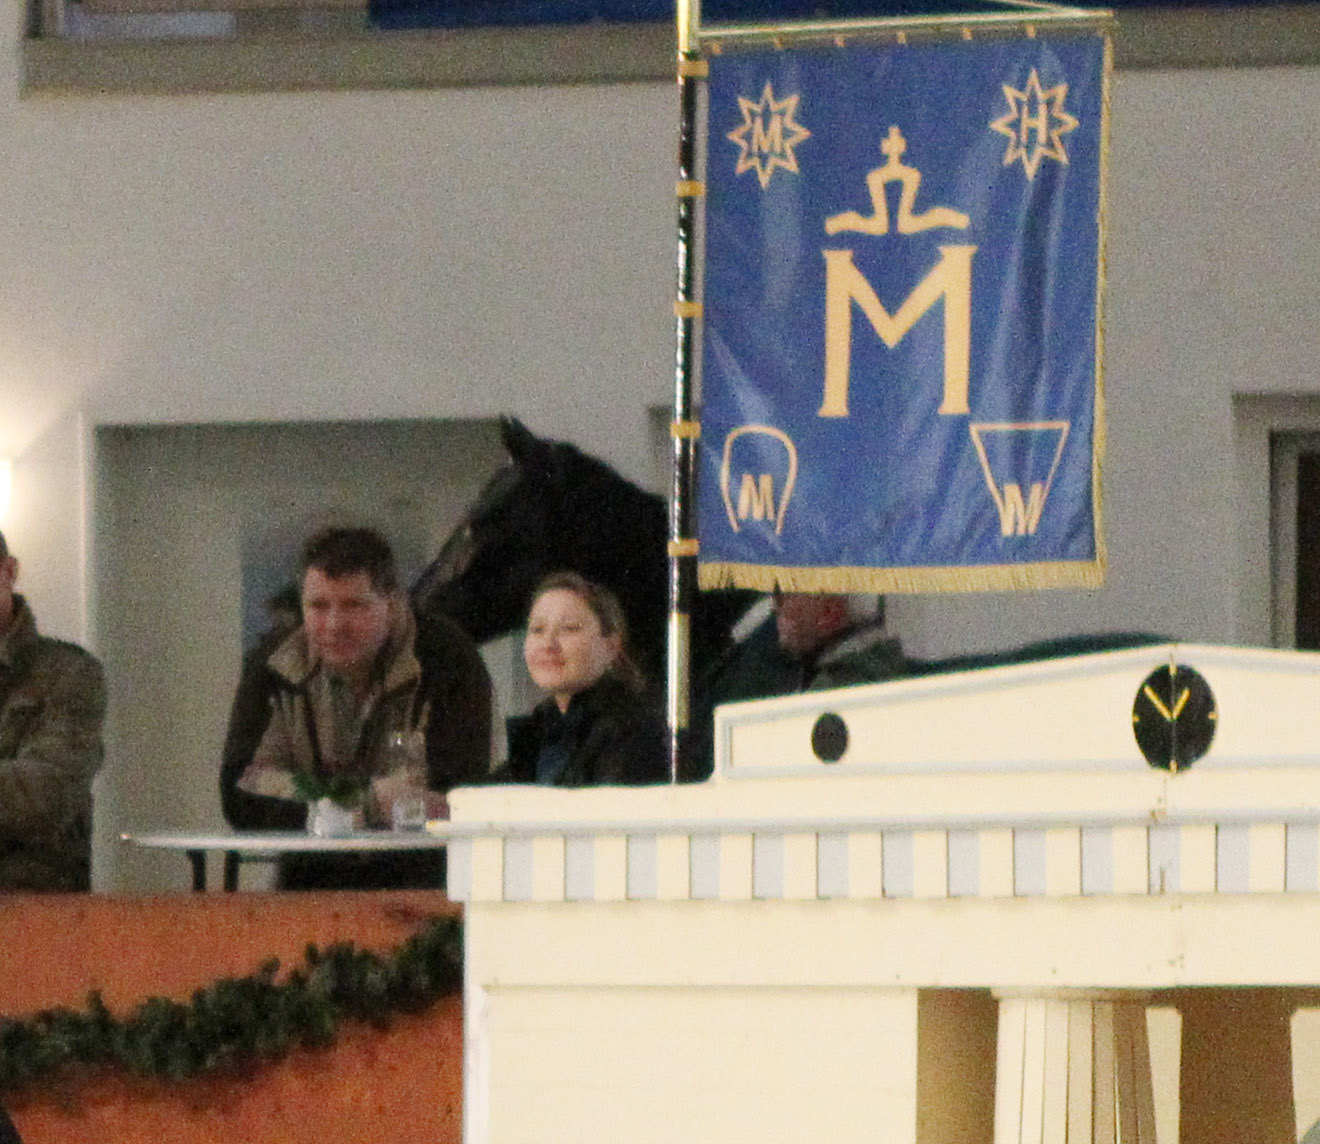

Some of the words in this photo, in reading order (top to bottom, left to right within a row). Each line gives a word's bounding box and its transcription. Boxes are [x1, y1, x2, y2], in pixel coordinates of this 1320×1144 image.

[752, 114, 783, 155] M
[1021, 102, 1048, 144] H
[818, 245, 977, 417] M
[738, 474, 775, 520] M
